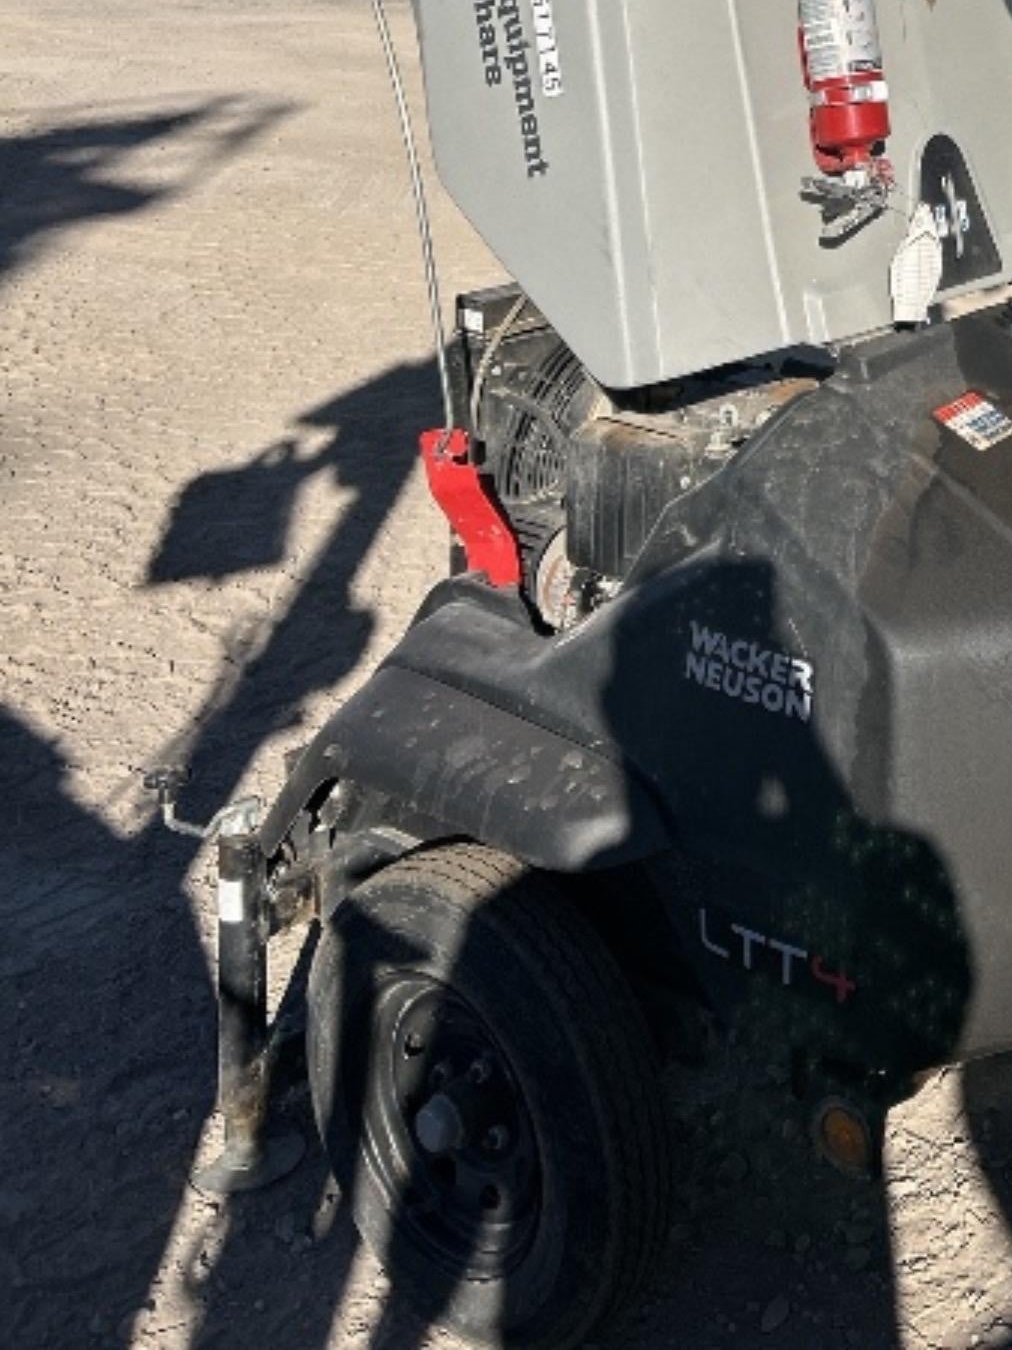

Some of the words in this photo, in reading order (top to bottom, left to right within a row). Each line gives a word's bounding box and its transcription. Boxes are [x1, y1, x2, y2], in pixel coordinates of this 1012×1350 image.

[685, 651, 811, 723] NEUSON
[689, 620, 814, 693] WACKER
[699, 908, 856, 1002] LTT4
